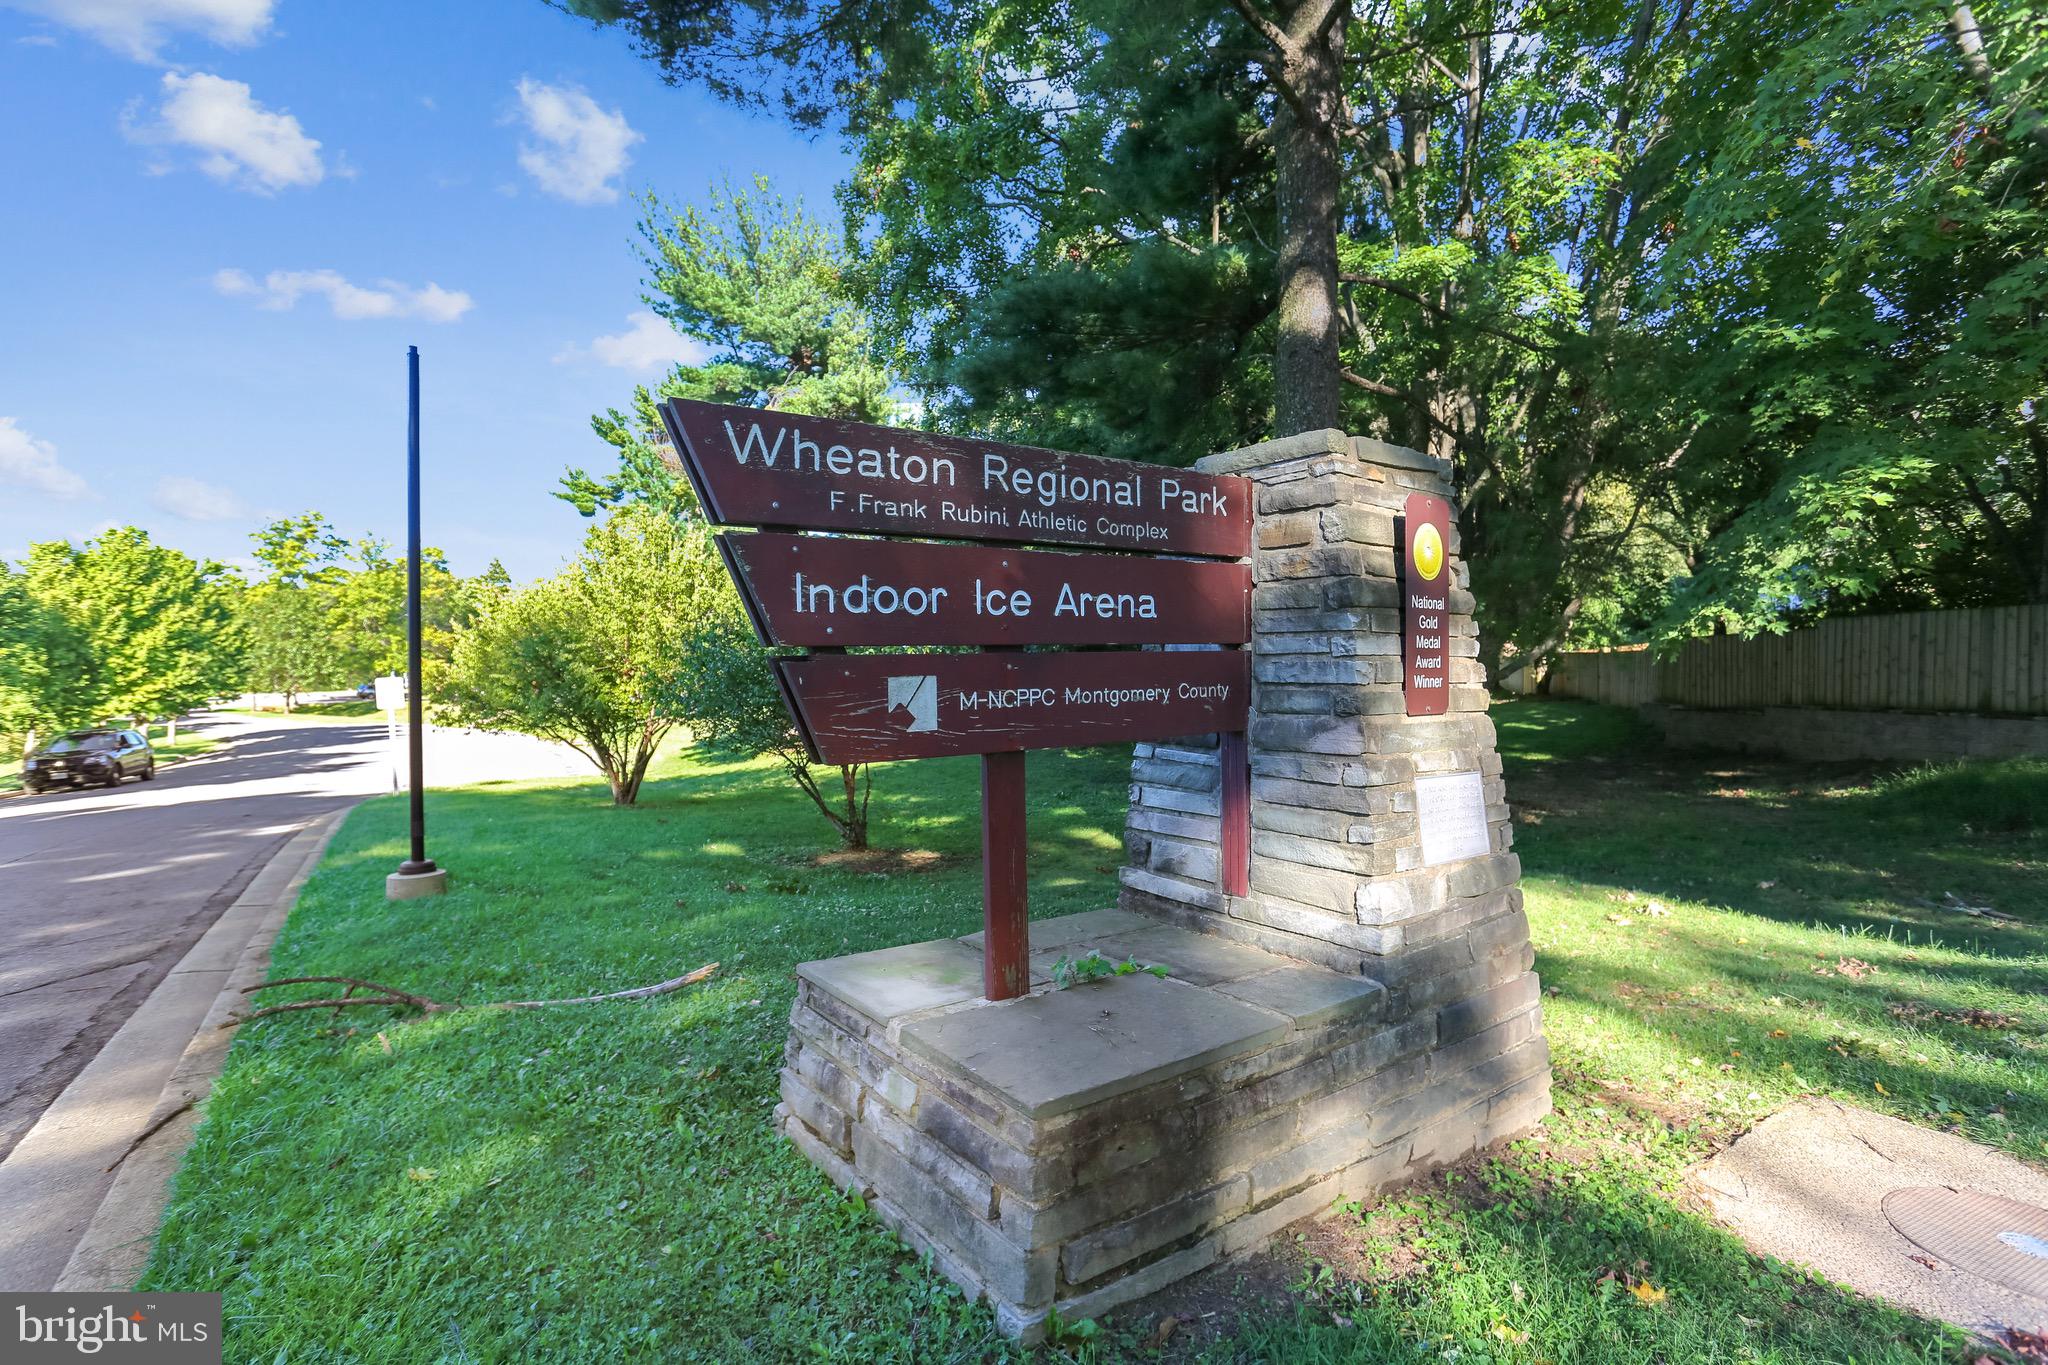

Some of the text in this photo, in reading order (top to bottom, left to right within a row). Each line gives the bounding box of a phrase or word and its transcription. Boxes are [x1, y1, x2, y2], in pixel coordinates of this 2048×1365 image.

[724, 420, 1228, 517] Wheaton Regional Park
[1018, 509, 1087, 533] Athletic
[1096, 517, 1169, 541] Complex
[795, 572, 1157, 619] Indoor Ice Arena
[1411, 595, 1445, 610] National
[1418, 614, 1438, 629] Gold
[1416, 635, 1441, 649] Medal
[1415, 655, 1441, 669] Award
[1413, 675, 1443, 689] Winner
[1064, 687, 1171, 707] Montgomery
[1178, 682, 1229, 702] County
